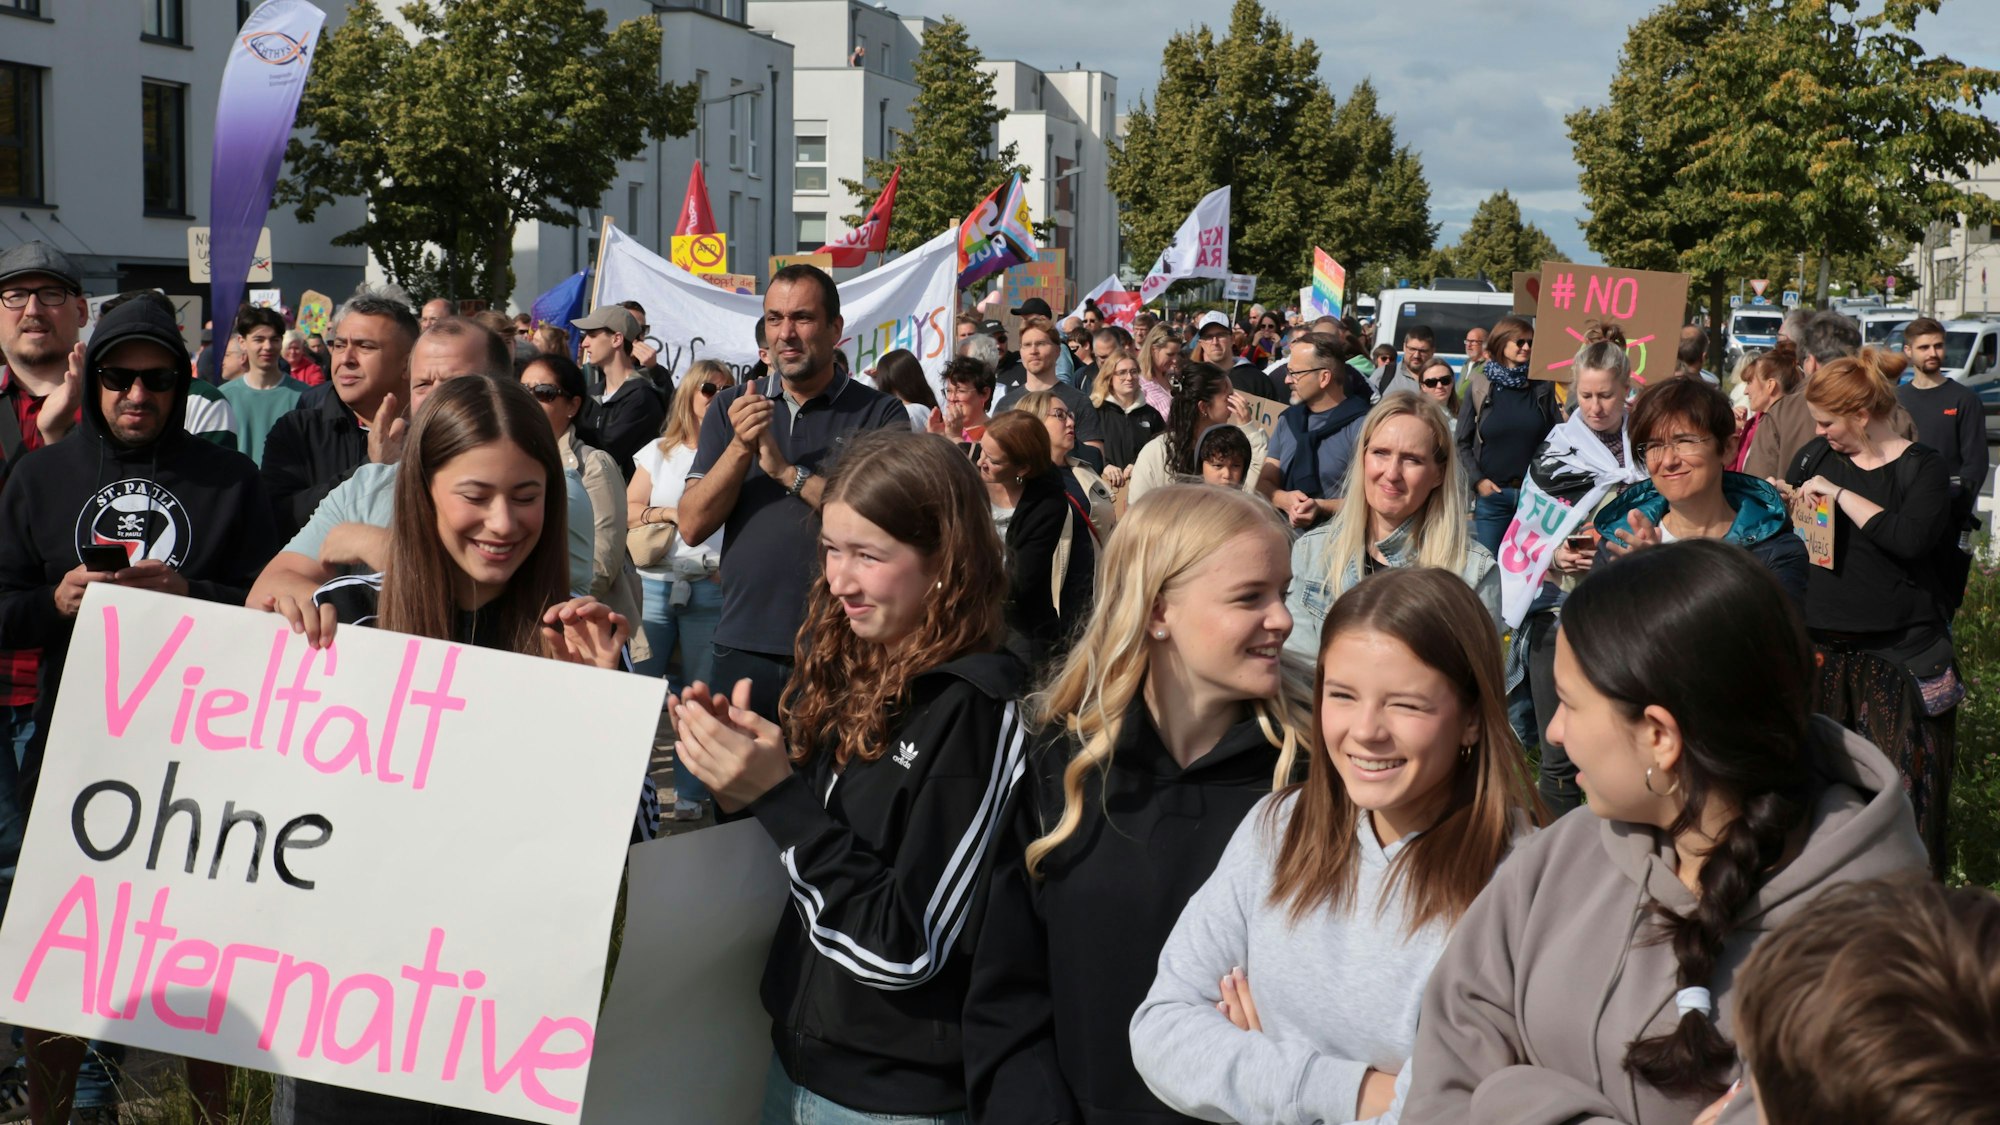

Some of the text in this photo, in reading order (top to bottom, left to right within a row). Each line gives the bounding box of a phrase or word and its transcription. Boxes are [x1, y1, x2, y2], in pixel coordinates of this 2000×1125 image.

[102, 605, 467, 790] Vielfalt
[71, 761, 333, 890] ohne
[13, 875, 595, 1115] Alternative
